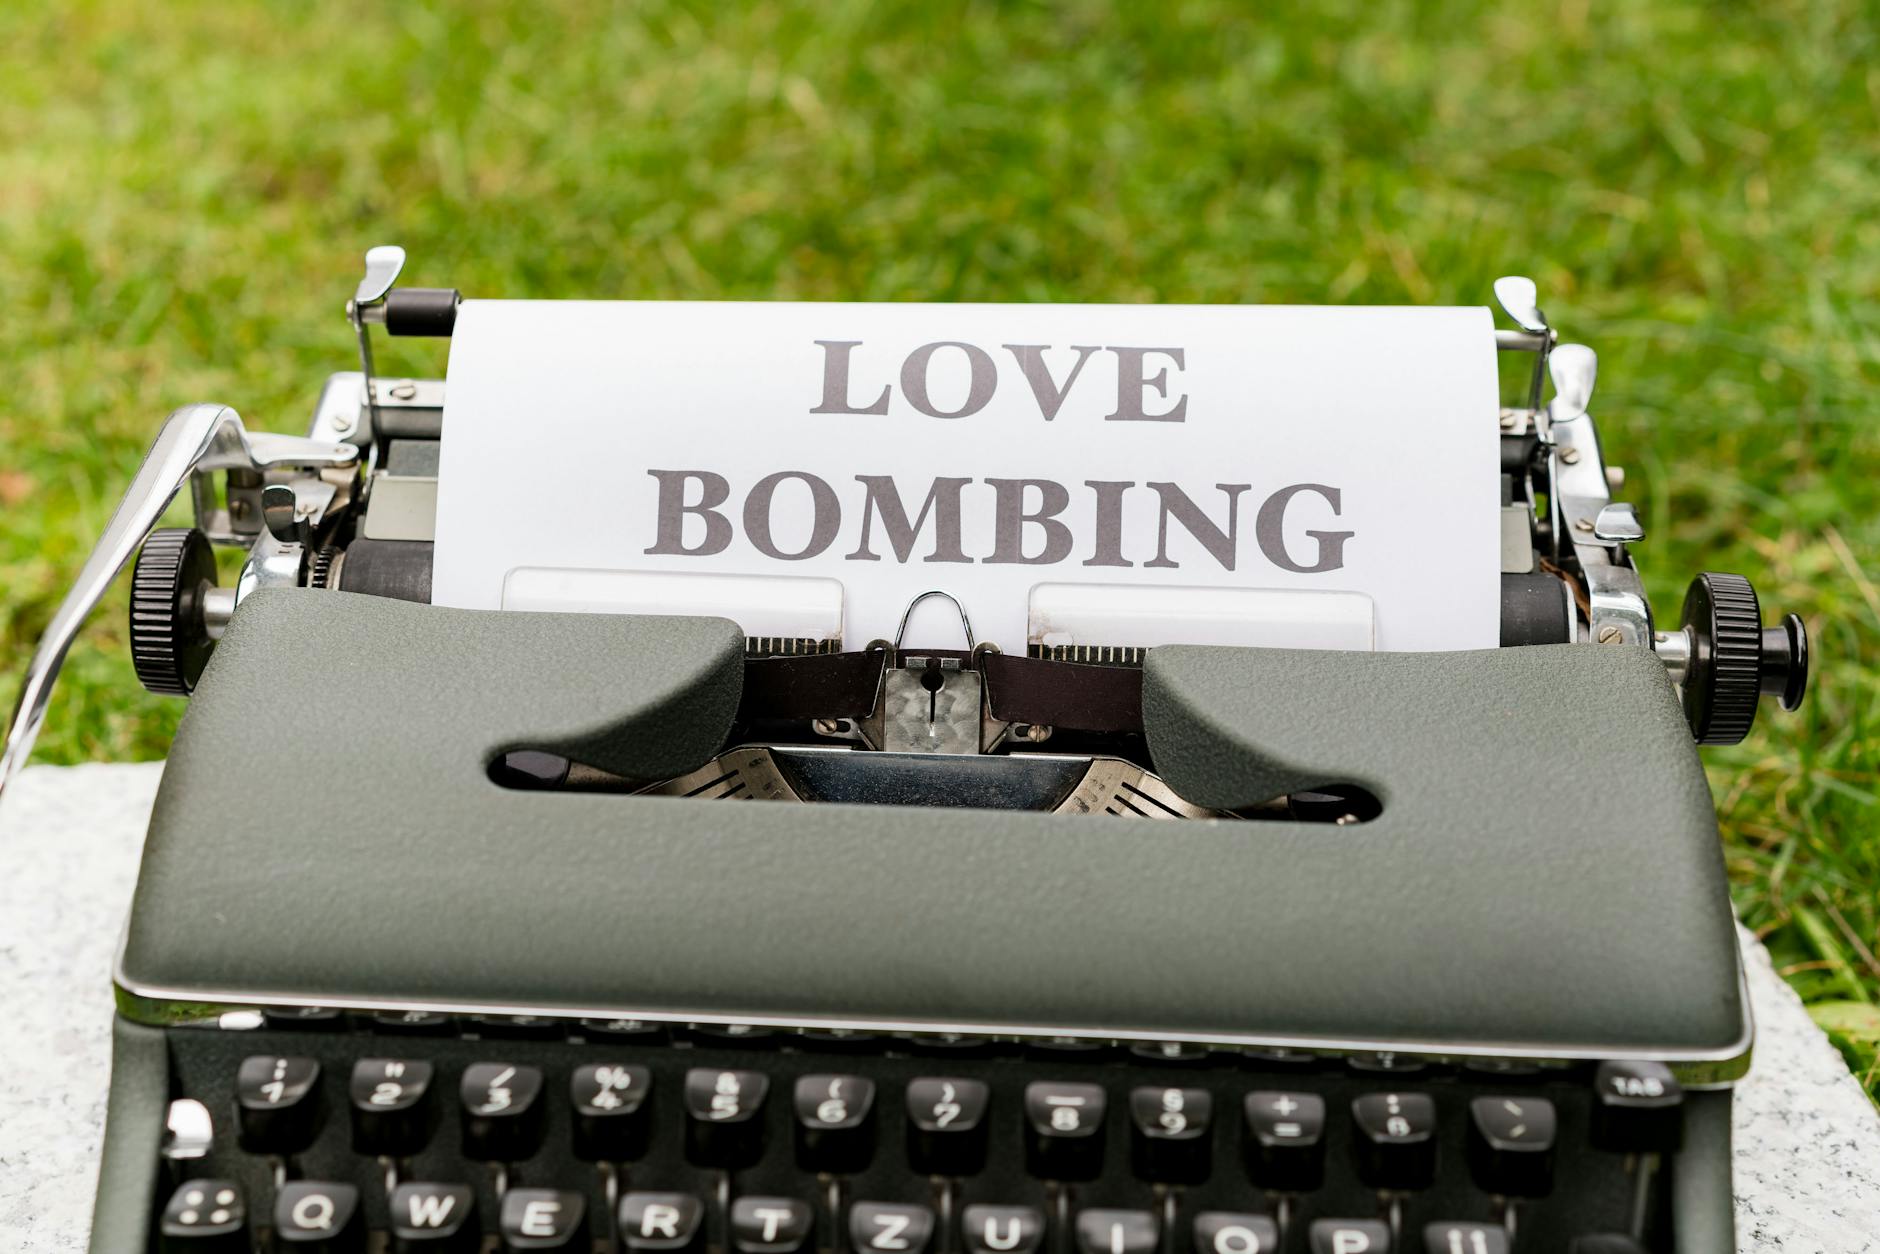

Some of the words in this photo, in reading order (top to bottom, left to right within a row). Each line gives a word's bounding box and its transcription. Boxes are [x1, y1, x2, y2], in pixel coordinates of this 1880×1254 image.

[810, 341, 1187, 422] LOVE
[644, 469, 1354, 573] BOMBING
[261, 1081, 285, 1103] 1
[370, 1082, 402, 1104] 2
[481, 1088, 512, 1112] 3
[591, 1090, 622, 1110] 4
[1611, 1077, 1664, 1096] TAB
[709, 1094, 739, 1120] 5
[817, 1099, 847, 1123] 6
[933, 1103, 961, 1128] 7
[1051, 1107, 1079, 1131] 8
[1160, 1112, 1187, 1135] 9
[292, 1194, 334, 1230] Q
[409, 1195, 456, 1227] W
[521, 1201, 561, 1236] E
[640, 1204, 680, 1238] R
[753, 1208, 792, 1242] T
[871, 1214, 910, 1249] Z
[984, 1216, 1021, 1250] U
[1111, 1222, 1124, 1254] I
[1214, 1225, 1259, 1254] O
[1333, 1229, 1370, 1254] P
